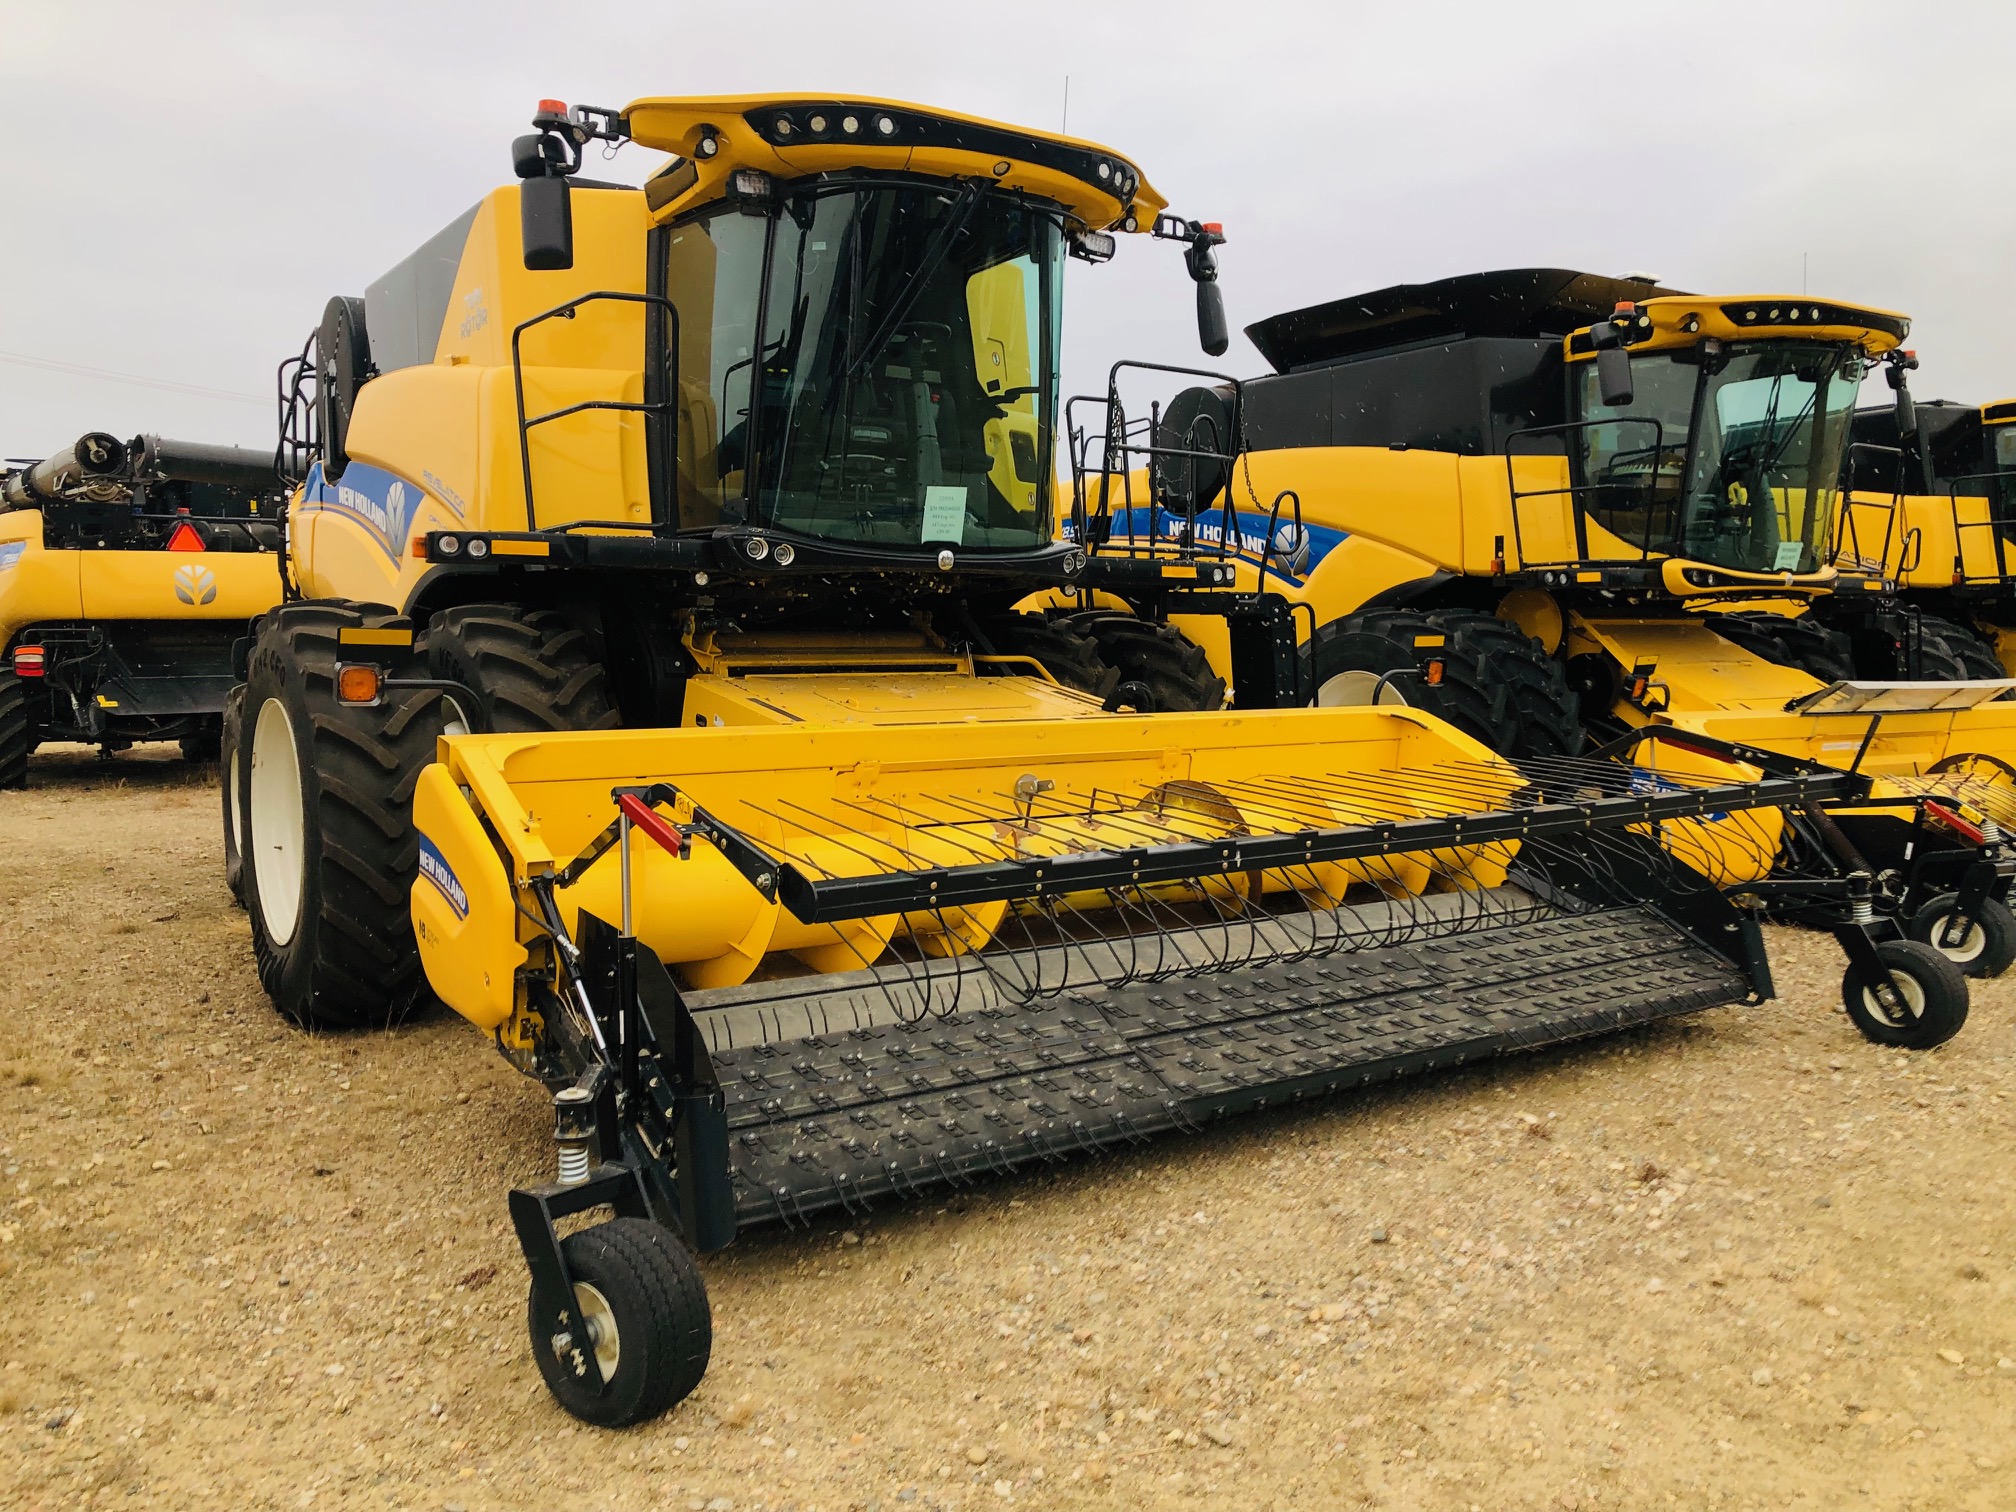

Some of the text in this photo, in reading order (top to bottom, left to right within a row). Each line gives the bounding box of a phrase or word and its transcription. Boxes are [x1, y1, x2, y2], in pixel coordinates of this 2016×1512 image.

[338, 486, 386, 533] NEW HOLLAND
[1203, 524, 1267, 555] HOLLAND
[420, 848, 466, 910] NEW HOLLAND
